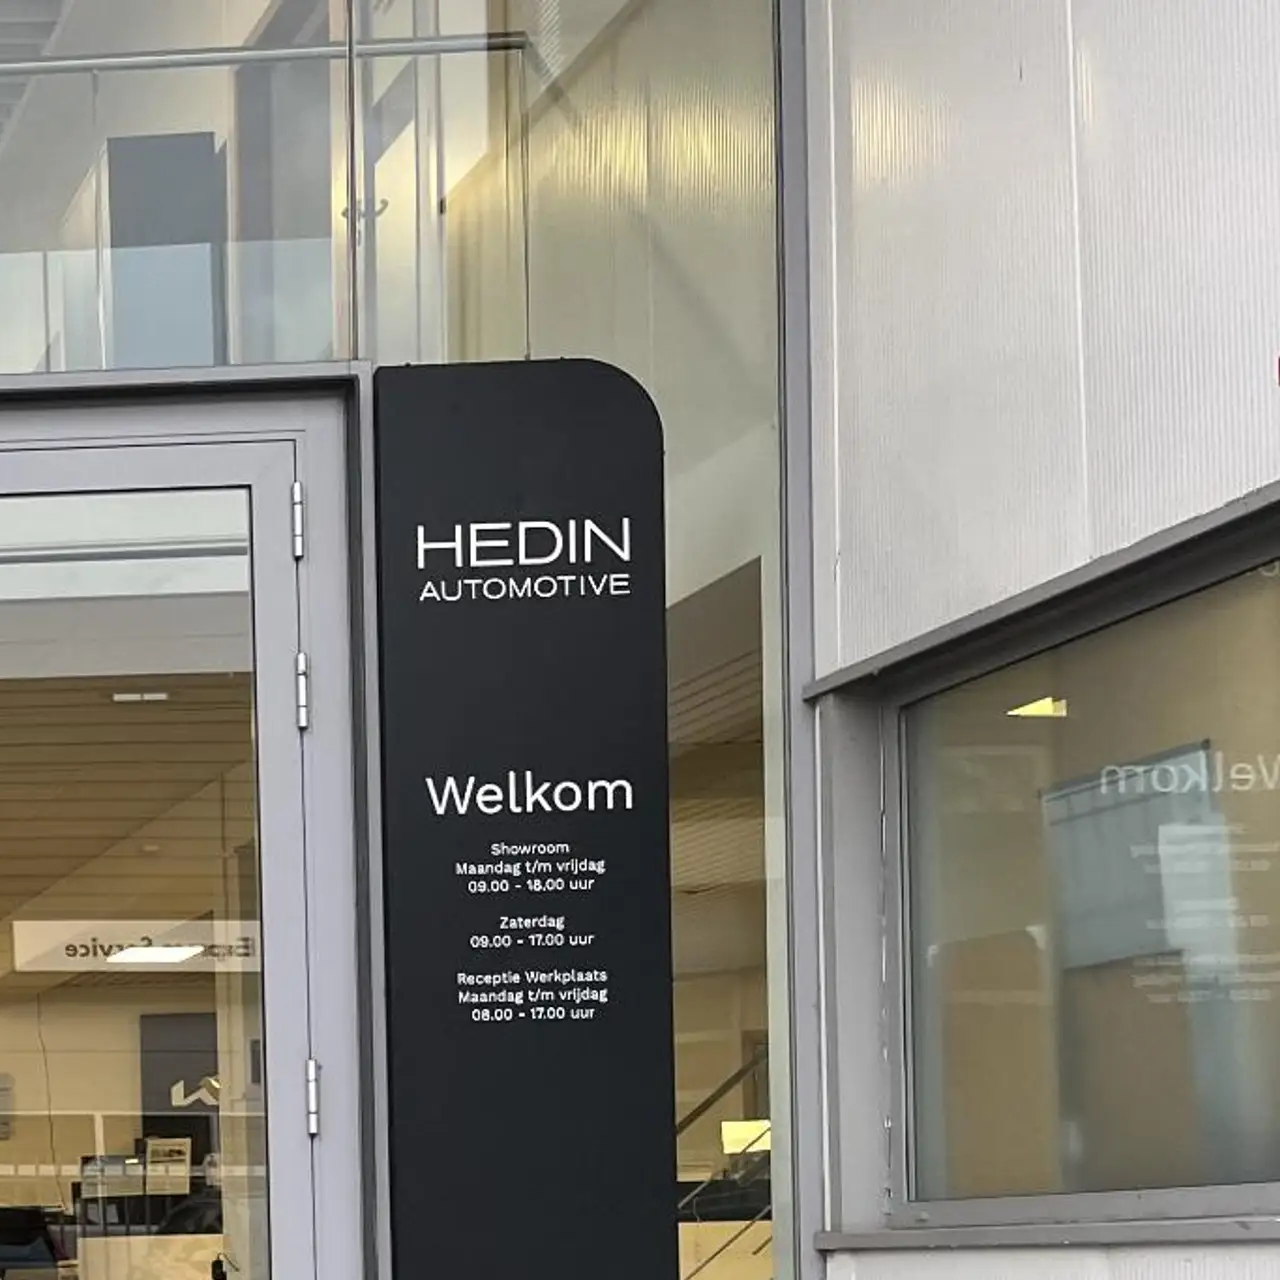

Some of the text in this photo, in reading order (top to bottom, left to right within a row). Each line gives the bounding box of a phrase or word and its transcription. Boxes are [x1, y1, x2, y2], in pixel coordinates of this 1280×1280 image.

[417, 517, 631, 570] HEDIN
[419, 573, 631, 602] AUTOMOTIVE
[425, 770, 633, 815] Welkom
[490, 842, 570, 856] Showroom
[455, 858, 606, 876] Maandag t/m vrijdag
[468, 879, 510, 893] 09.00
[526, 878, 565, 892] 18.00
[569, 878, 595, 890] uur
[500, 915, 565, 930] Zaterdag
[469, 935, 512, 948] 09.00
[528, 934, 565, 947] 17.00
[569, 934, 595, 946] uur
[457, 969, 608, 986] Receptie Werkplaats
[458, 988, 608, 1004] Maandag t/m vrijdag
[471, 1008, 513, 1021] 08.00
[530, 1007, 566, 1020] 17.00
[570, 1008, 595, 1019] uur
